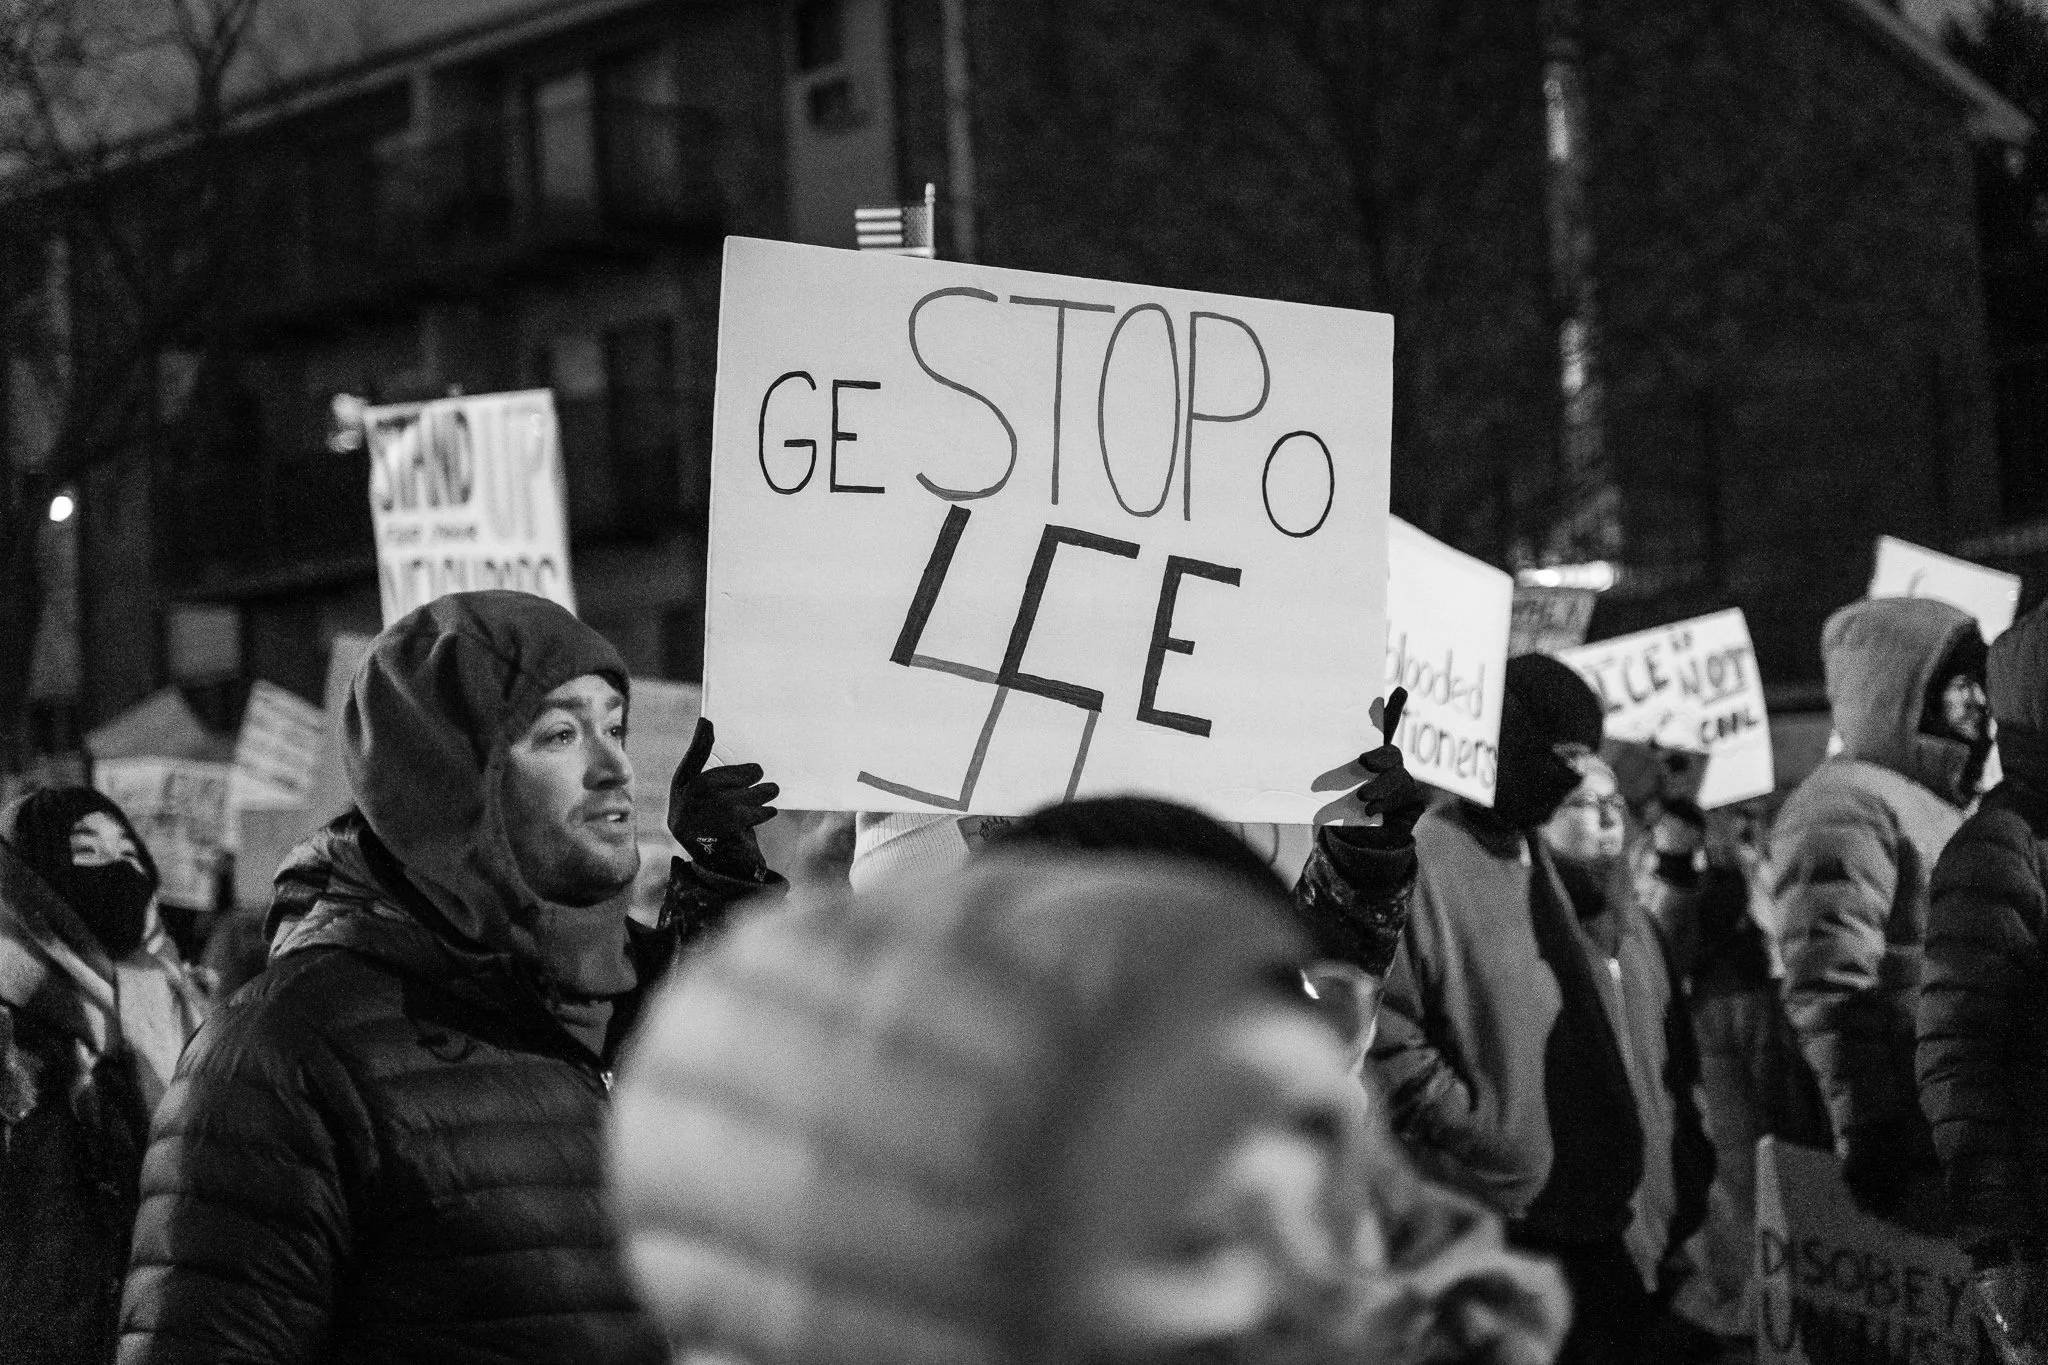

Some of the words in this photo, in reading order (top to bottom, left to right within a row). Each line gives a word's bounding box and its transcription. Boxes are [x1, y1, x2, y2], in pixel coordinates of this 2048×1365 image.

[889, 504, 1243, 738] ICE
[1583, 643, 1671, 714] ICE
[1679, 646, 1748, 697] NOT
[1760, 1229, 1968, 1328] DISOBEY
